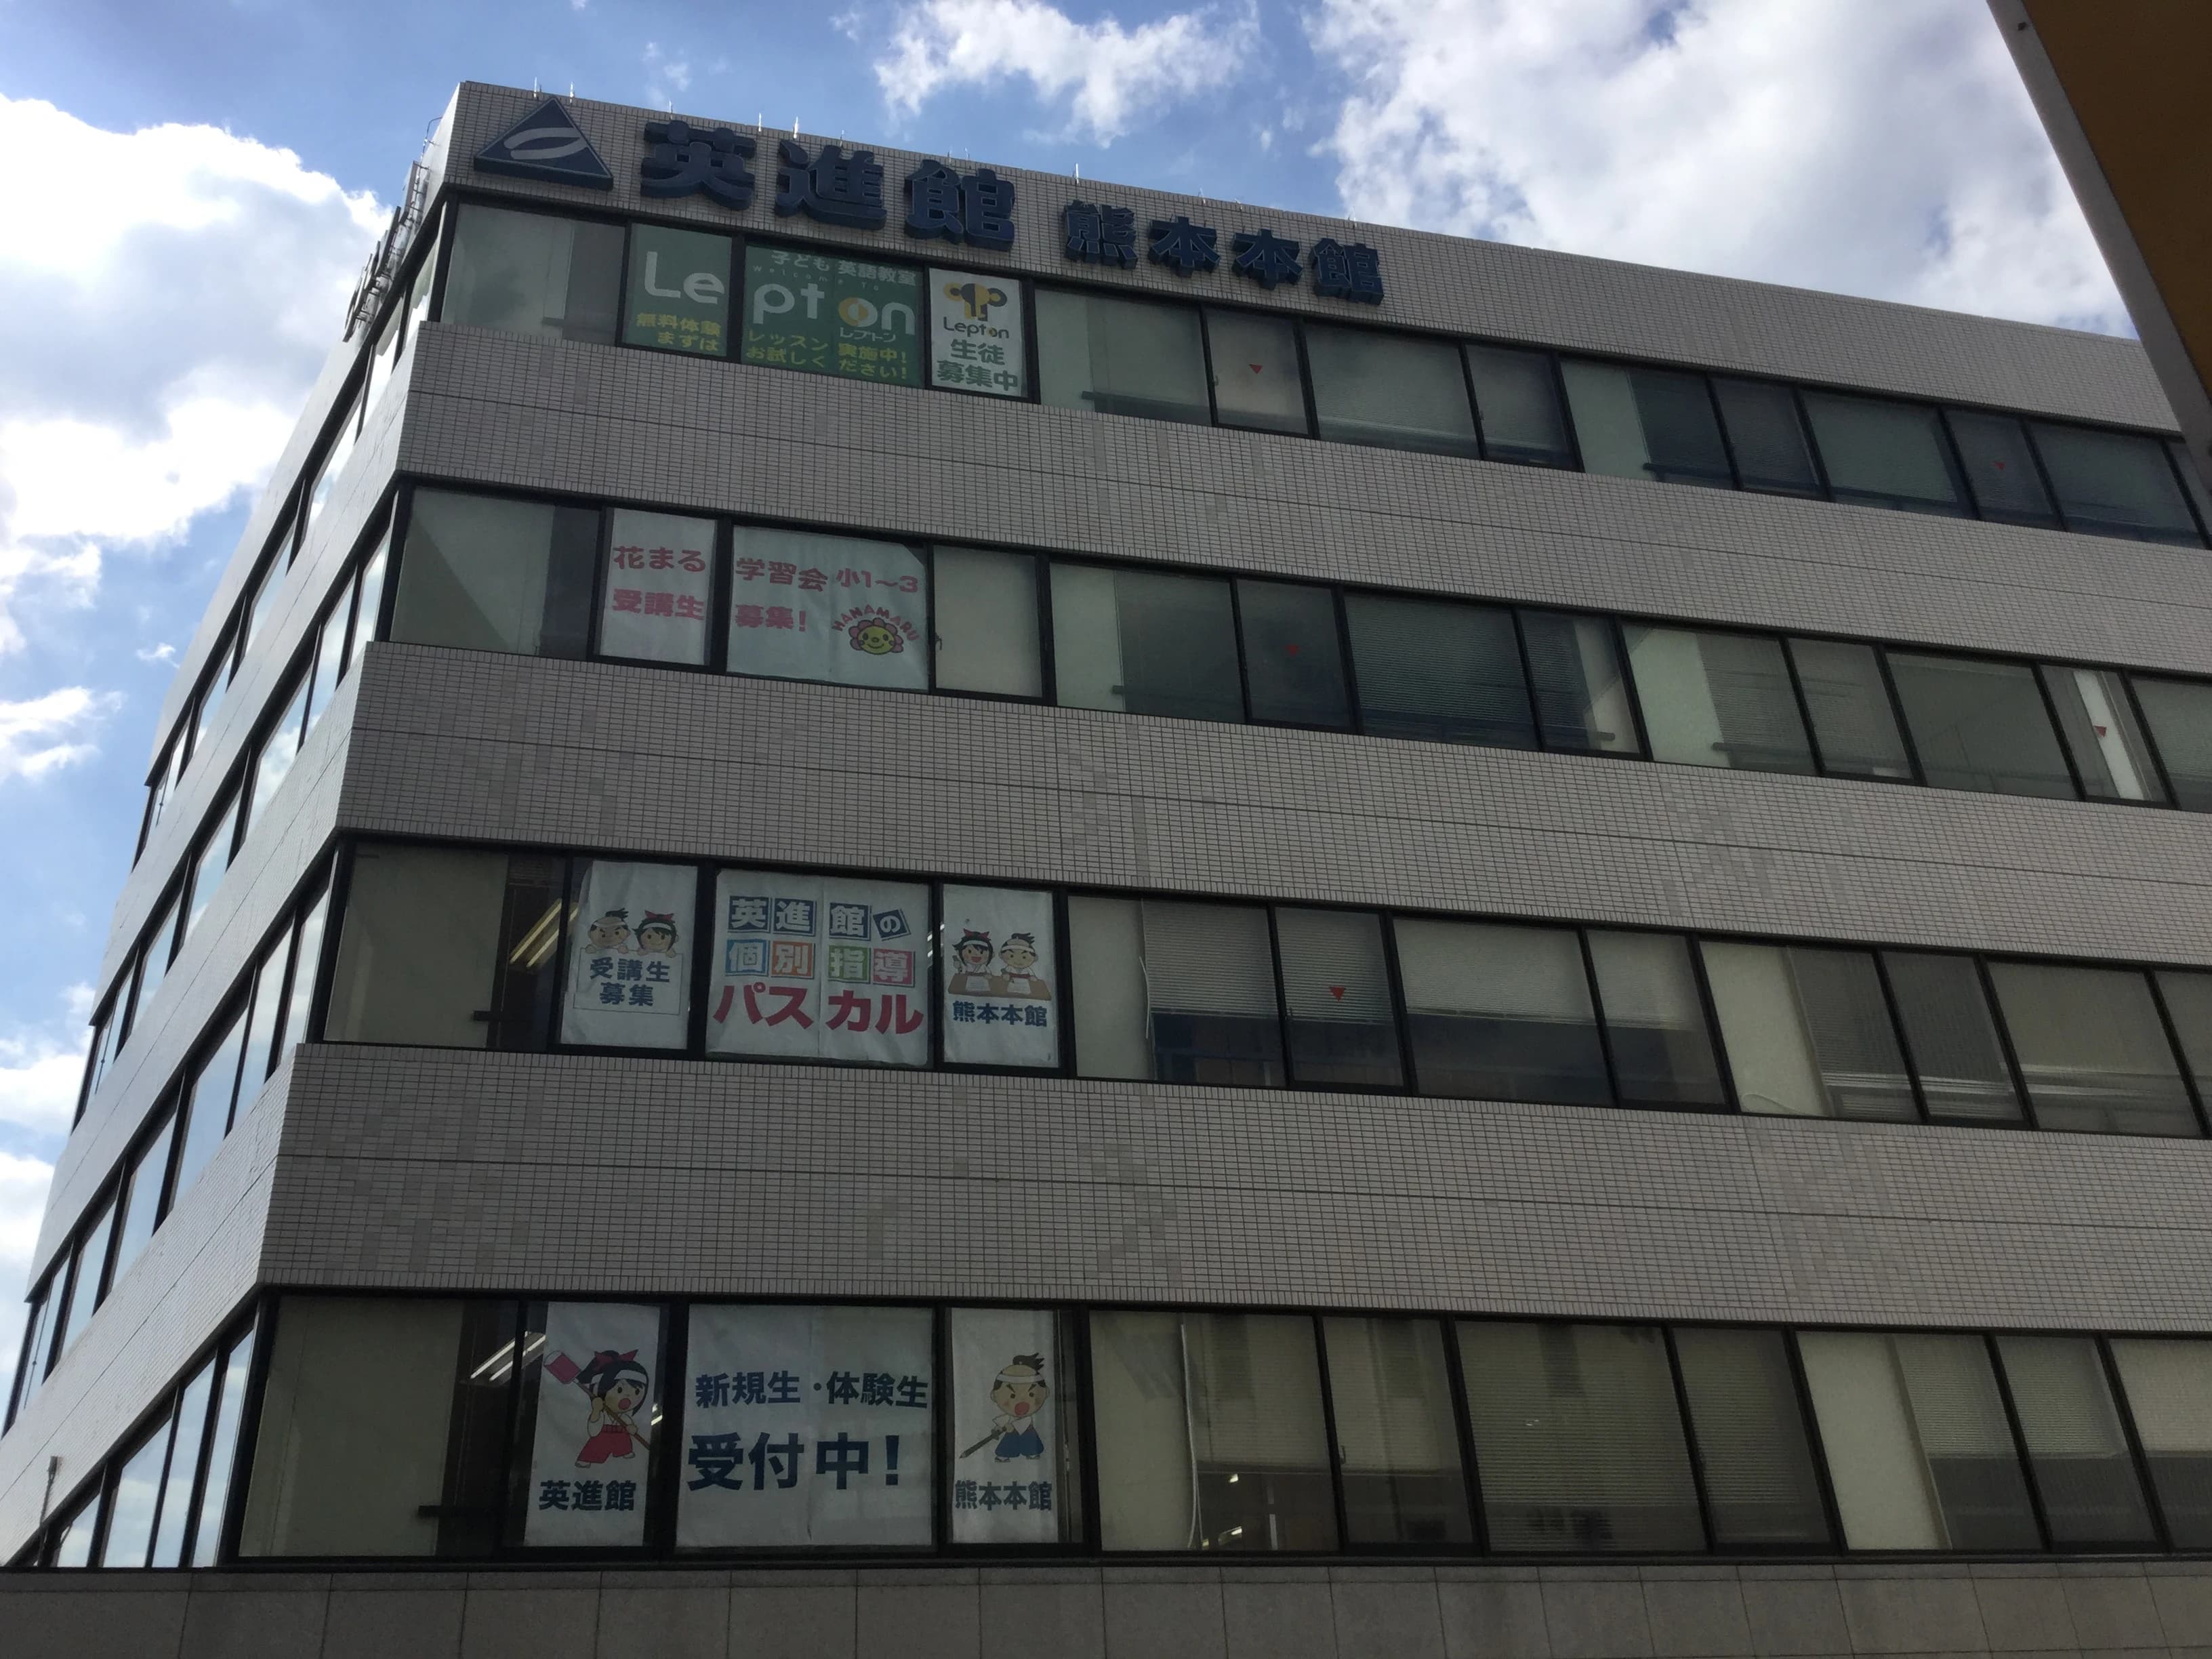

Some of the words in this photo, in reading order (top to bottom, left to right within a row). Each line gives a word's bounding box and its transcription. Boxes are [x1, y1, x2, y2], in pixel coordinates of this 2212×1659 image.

[640, 120, 1015, 251] 英進館
[1061, 199, 1385, 305] 熊本本館
[943, 316, 1009, 338] Lepton
[950, 339, 1006, 365] 生徒
[937, 359, 1018, 391] 募集中
[613, 546, 706, 572] 花まる
[613, 588, 705, 621] 受講生
[735, 604, 806, 632] 募集!
[831, 604, 920, 640] HANAMARU
[730, 897, 905, 938] 英進館の
[589, 958, 670, 983] 受講生
[727, 941, 912, 983] 個別指導
[599, 983, 655, 1007] 募集
[712, 982, 924, 1035] パスカル
[953, 1000, 1048, 1027] 熊本本館
[539, 1479, 636, 1511] 英進館
[955, 1479, 1052, 1511] 熊本本館
